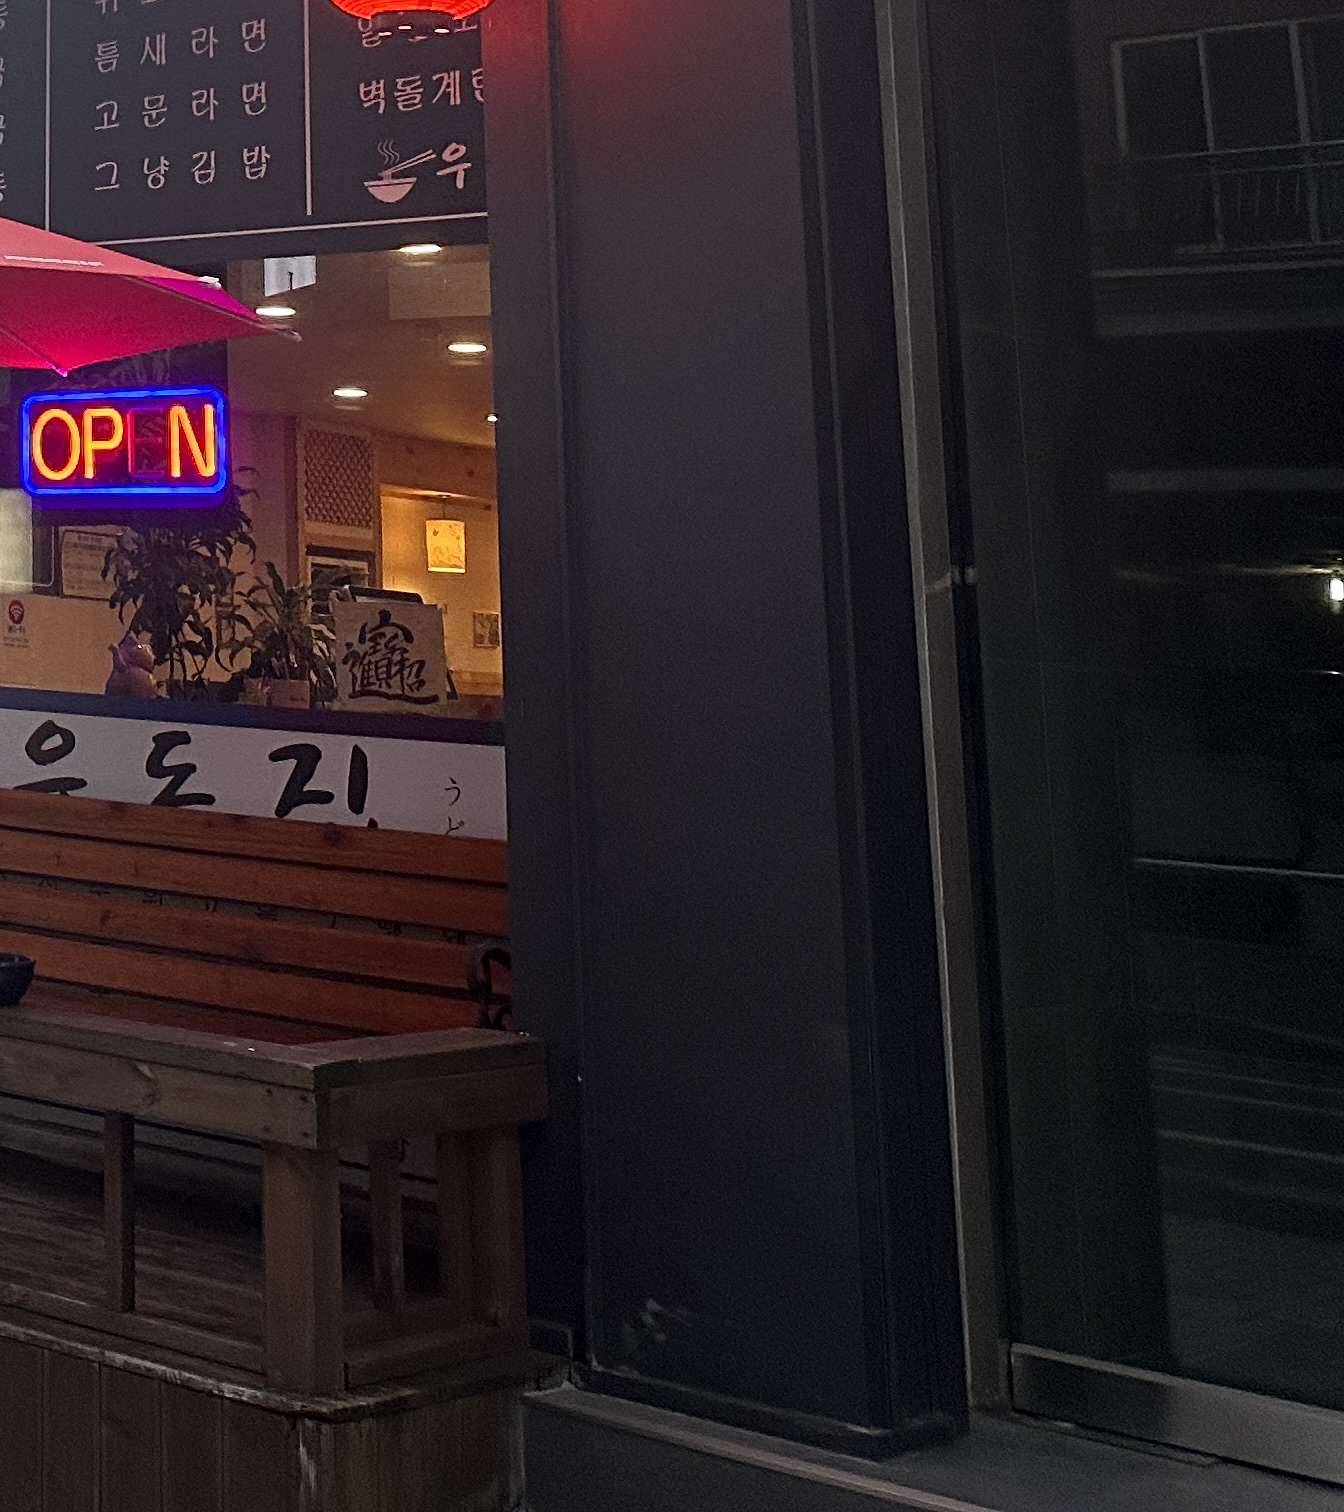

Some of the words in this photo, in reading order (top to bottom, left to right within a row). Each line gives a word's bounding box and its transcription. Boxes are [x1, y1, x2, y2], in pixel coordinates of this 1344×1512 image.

[94, 17, 267, 74] 틈새라면
[93, 81, 268, 129] 고문라면
[93, 145, 271, 192] 그냥김밥
